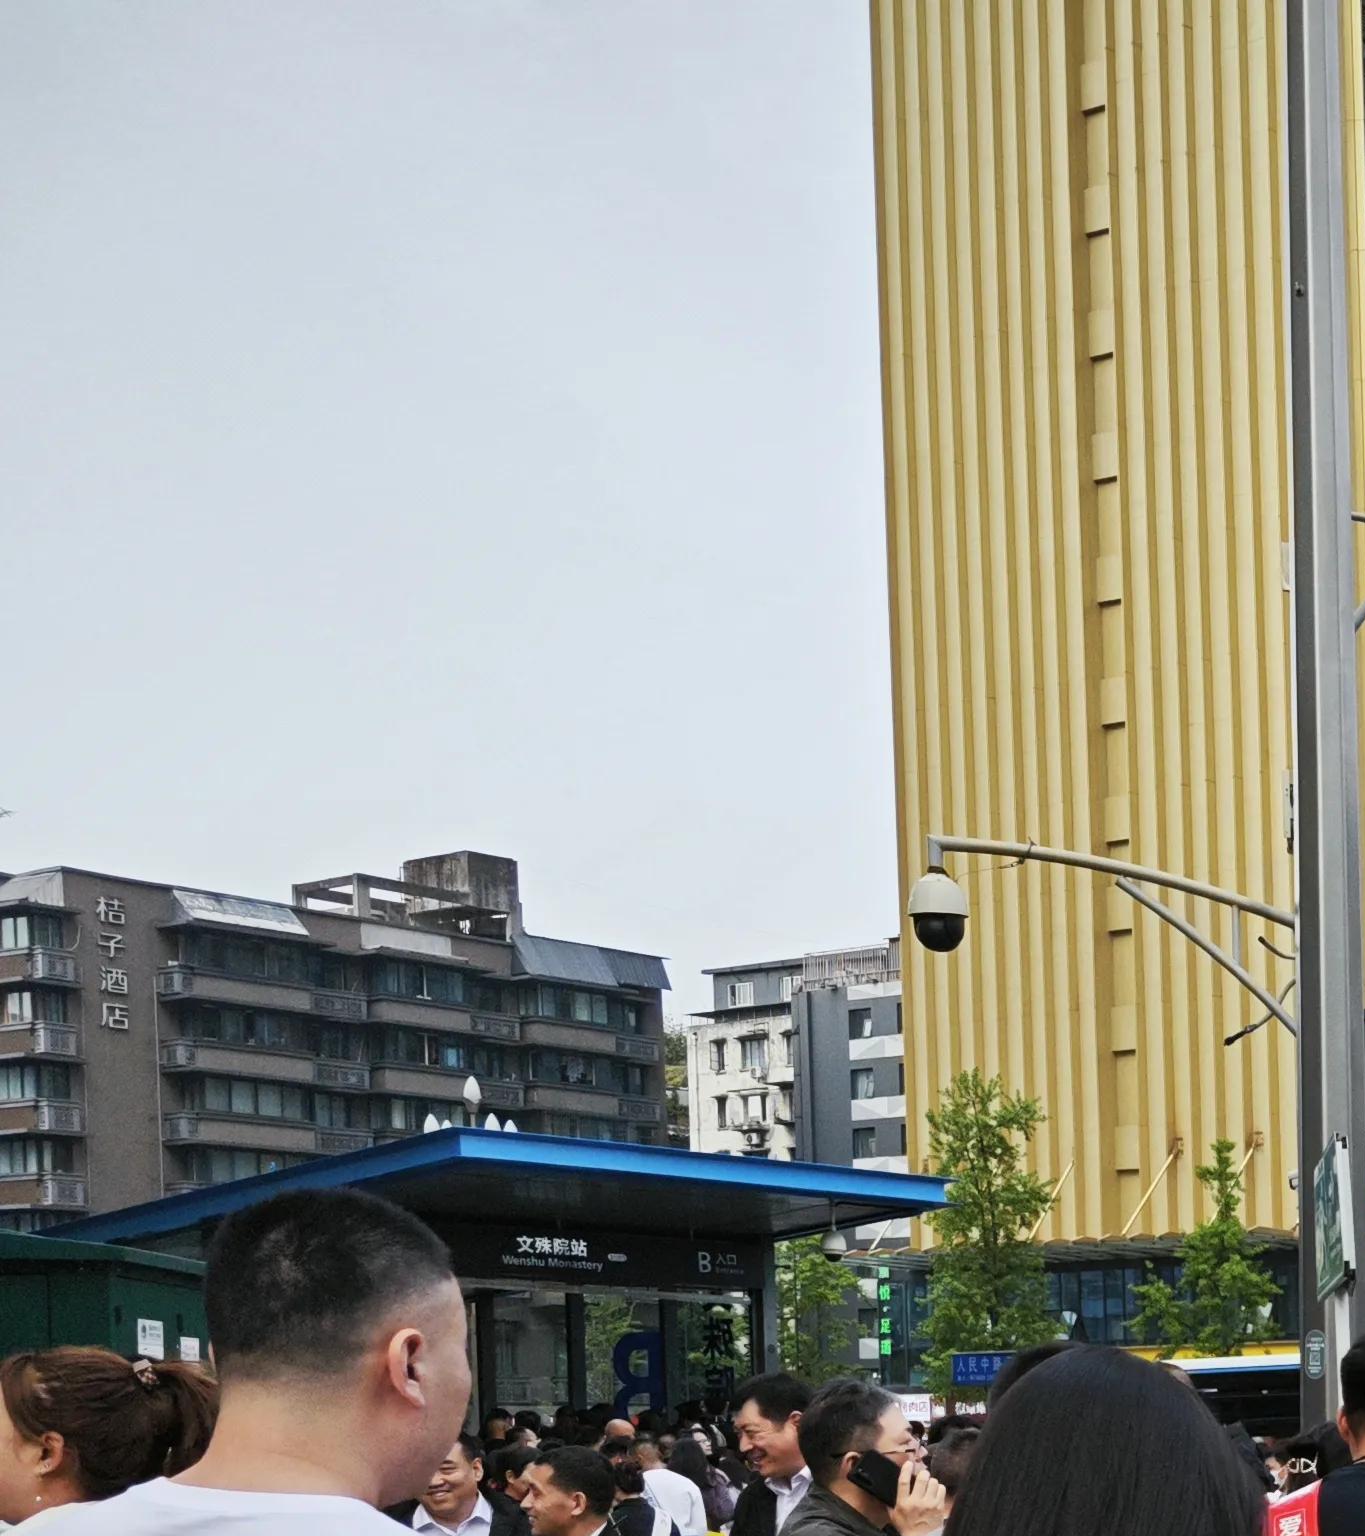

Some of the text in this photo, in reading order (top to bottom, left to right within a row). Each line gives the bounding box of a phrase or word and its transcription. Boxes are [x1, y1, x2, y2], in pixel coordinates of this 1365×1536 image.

[95, 895, 129, 1031] 桔子酒店
[516, 1235, 588, 1257] 文殊院站
[502, 1254, 546, 1268] Wenshu
[547, 1257, 604, 1273] Monastery
[698, 1251, 737, 1273] B 入口
